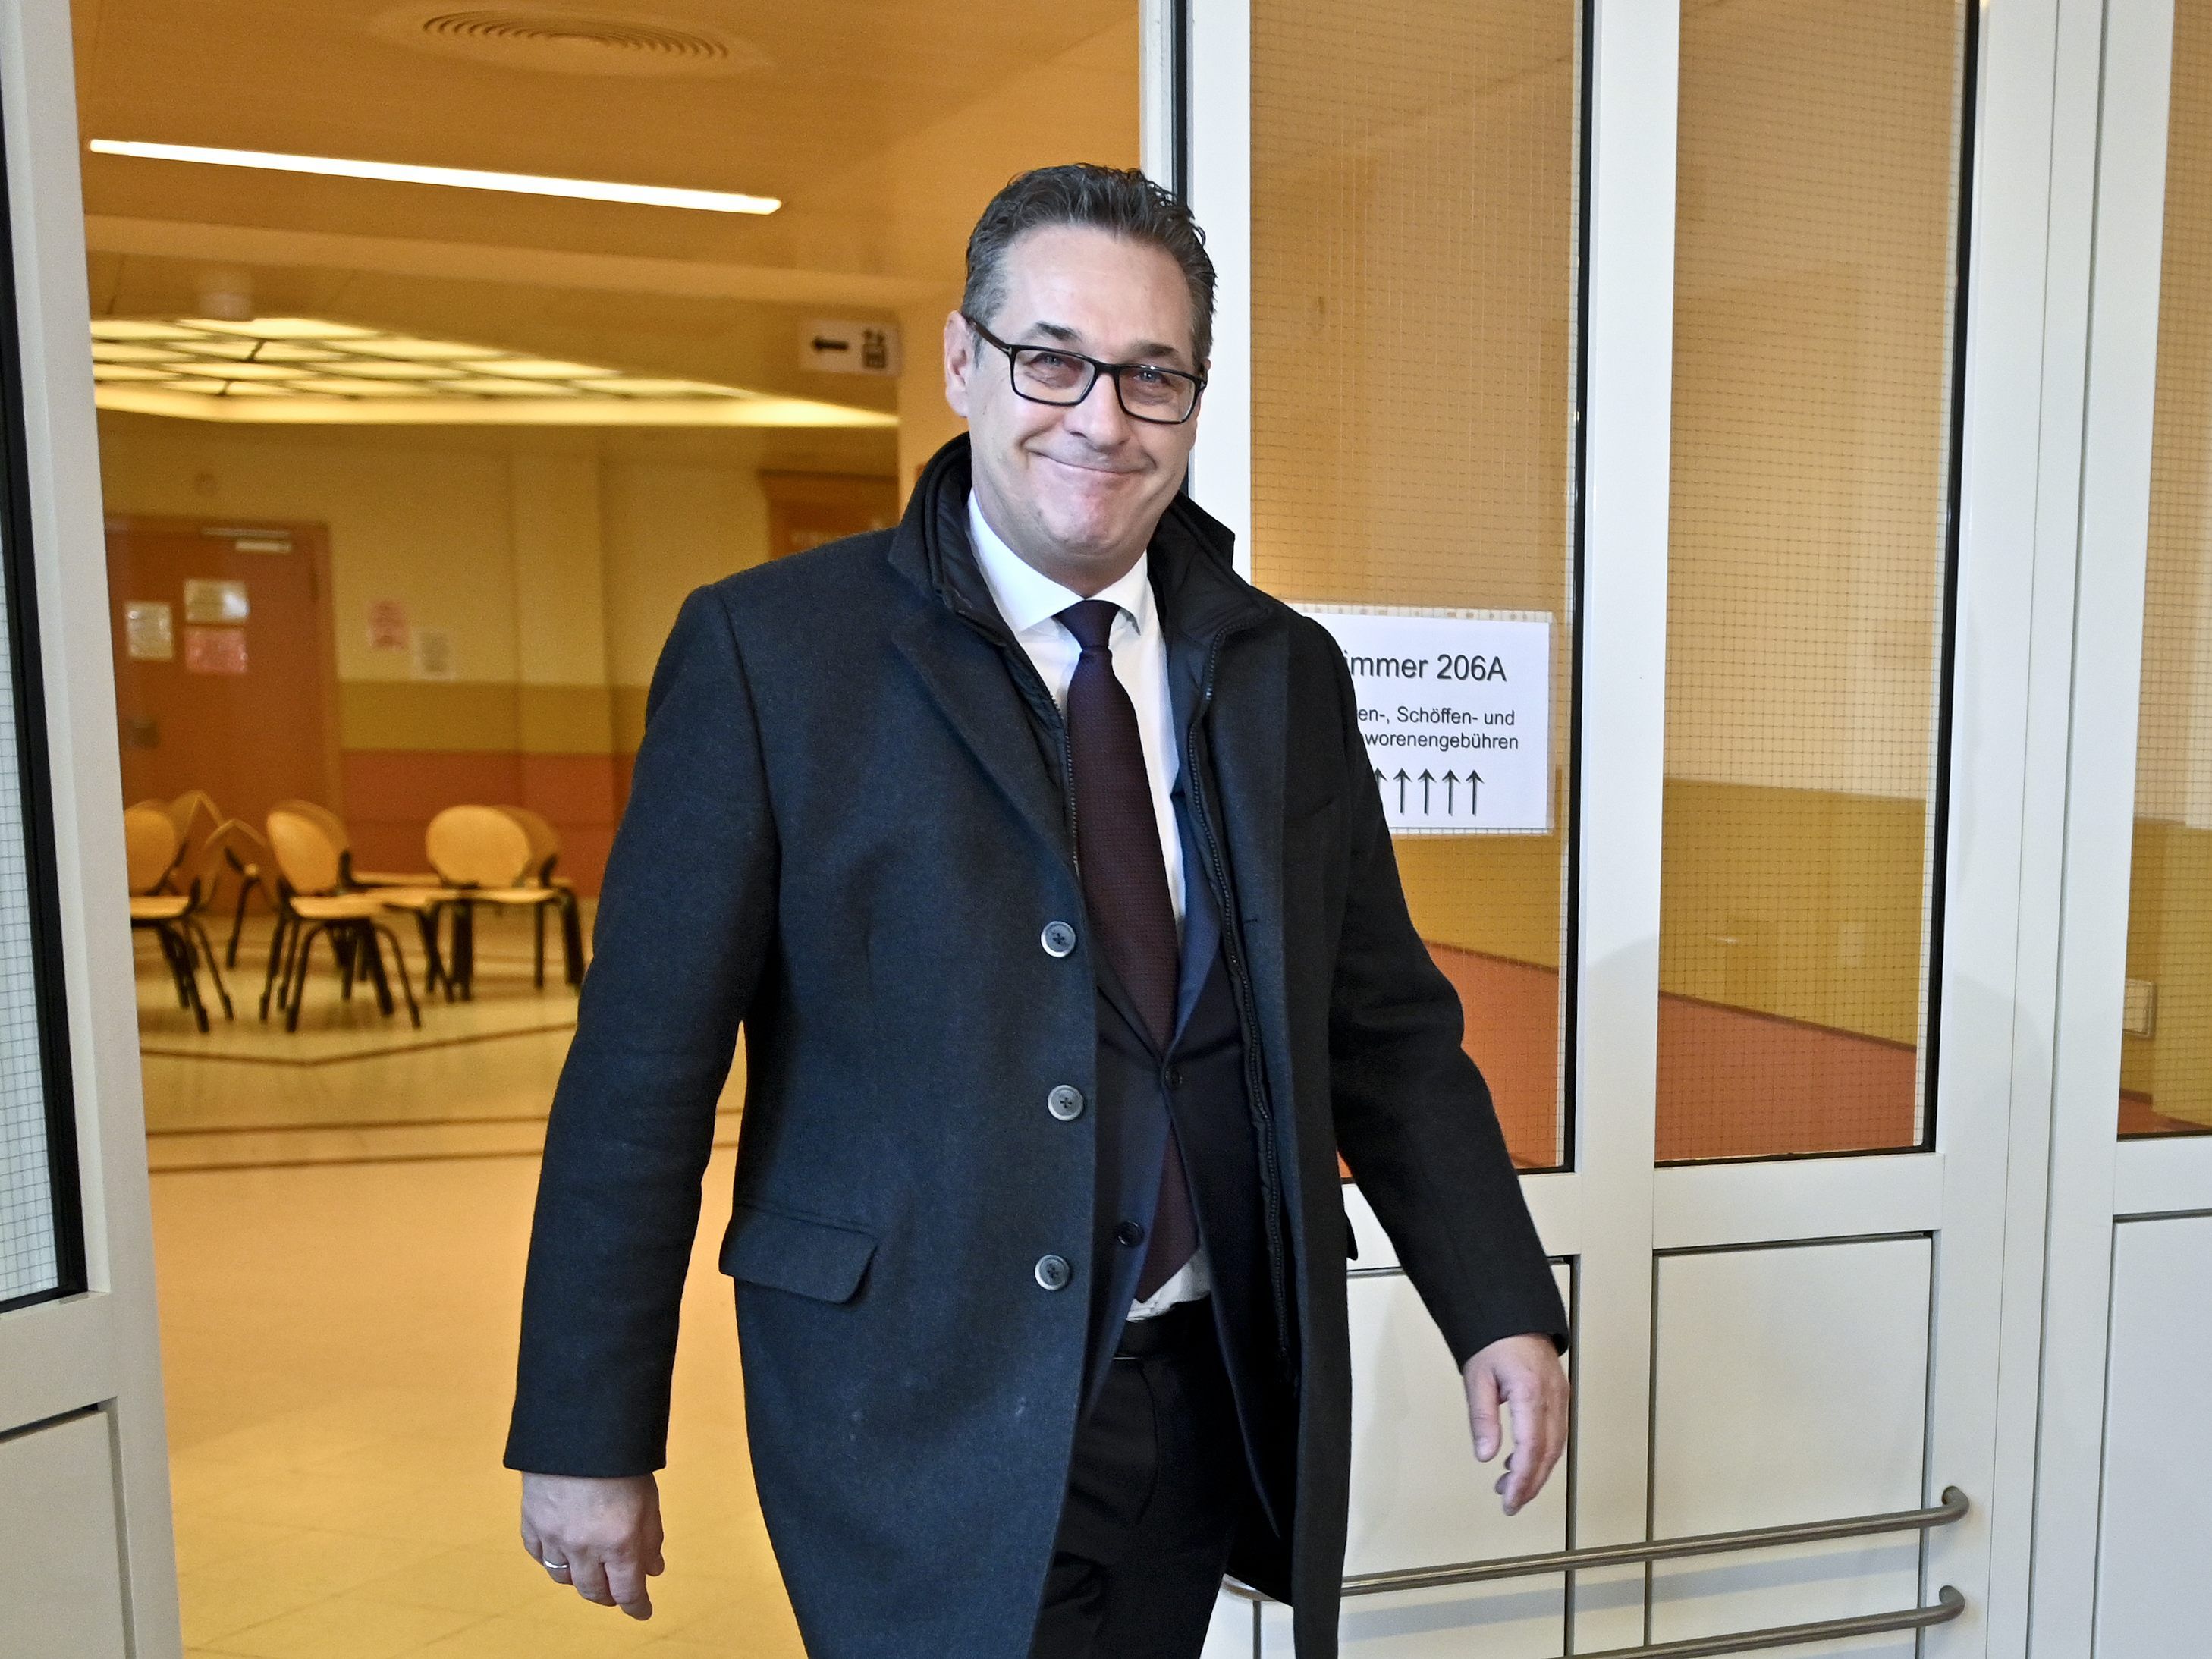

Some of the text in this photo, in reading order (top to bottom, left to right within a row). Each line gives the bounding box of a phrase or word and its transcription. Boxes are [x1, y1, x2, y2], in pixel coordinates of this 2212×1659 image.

[1343, 649, 1507, 682] mmer 206A
[1358, 705, 1515, 725] en-, Schöffen- und
[1365, 732, 1519, 752] worenengebühren
